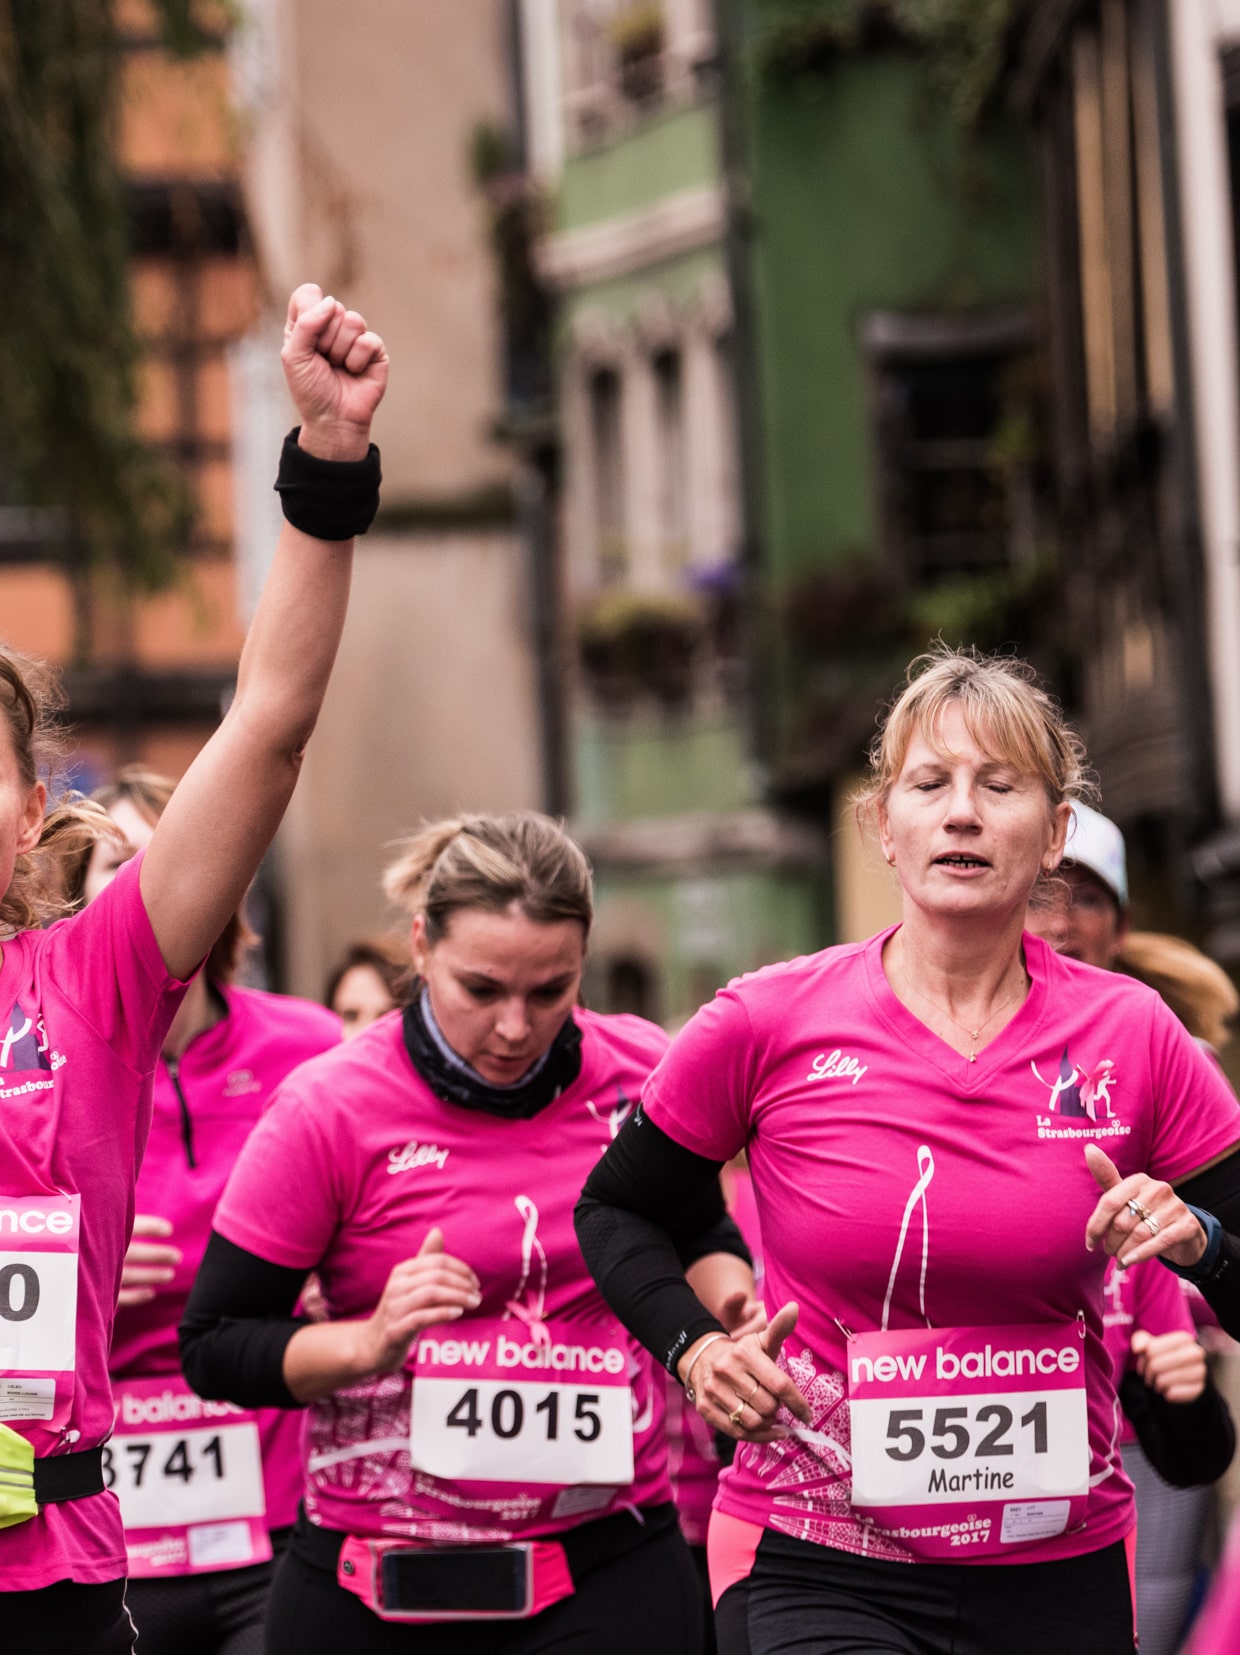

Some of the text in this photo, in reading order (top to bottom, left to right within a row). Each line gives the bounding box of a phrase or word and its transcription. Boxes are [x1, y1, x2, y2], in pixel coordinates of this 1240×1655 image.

[807, 1049, 868, 1084] Lilly
[1036, 1115, 1051, 1126] La
[387, 1140, 450, 1175] Lilly
[417, 1338, 491, 1366] new
[496, 1335, 626, 1374] balance
[851, 1344, 1081, 1383] new balance
[446, 1388, 602, 1442] 4015
[884, 1401, 1049, 1462] 5521
[928, 1466, 1014, 1493] Martine
[950, 1530, 990, 1546] 2017
